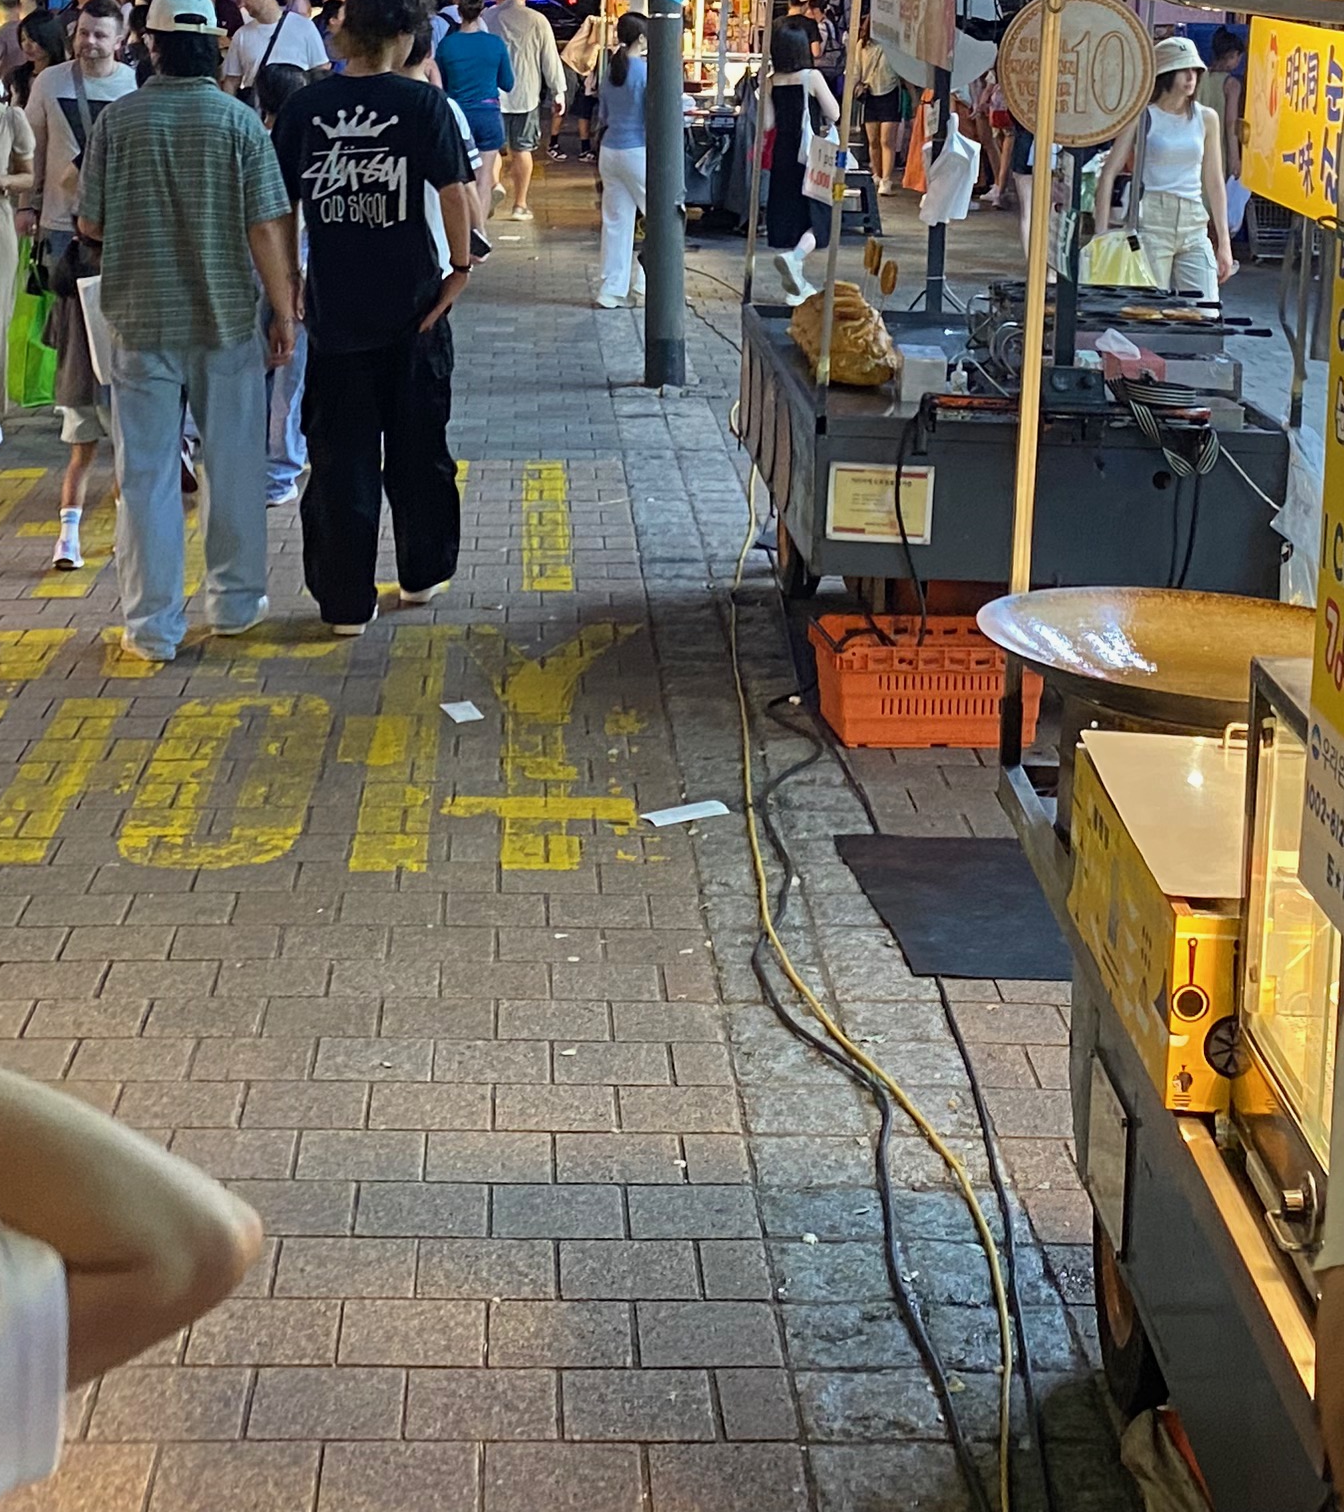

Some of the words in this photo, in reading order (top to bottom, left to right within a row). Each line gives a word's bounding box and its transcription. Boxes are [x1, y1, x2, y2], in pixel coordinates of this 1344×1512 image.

[1070, 29, 1136, 116] 10
[1285, 45, 1319, 115] 明洞
[1281, 130, 1315, 199] 一味
[319, 196, 344, 223] OLD
[348, 192, 397, 229] SKOOL
